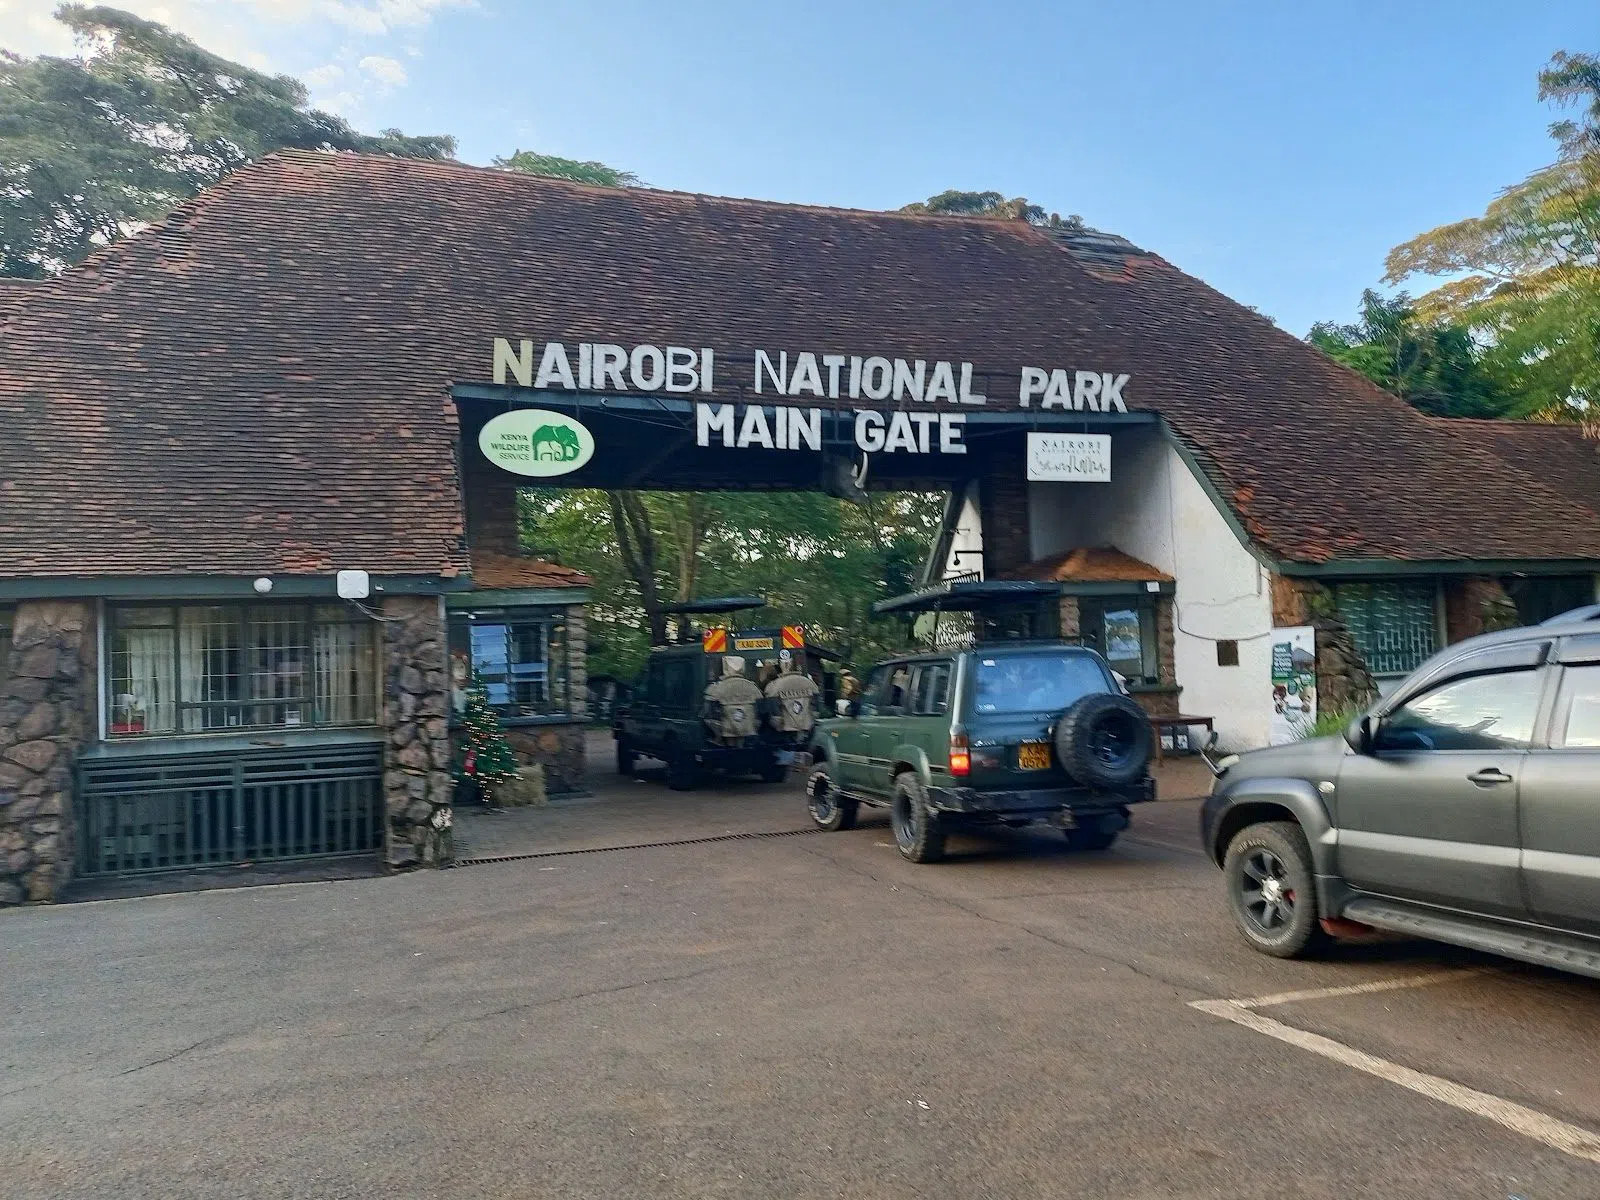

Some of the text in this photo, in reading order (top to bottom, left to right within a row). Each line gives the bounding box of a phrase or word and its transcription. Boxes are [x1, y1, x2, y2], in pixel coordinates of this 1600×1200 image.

[493, 337, 1131, 414] NAIROBI NATIONAL PARK
[696, 403, 968, 454] MAIN GATE
[500, 433, 528, 442] KENYA
[490, 442, 530, 452] WILDLIFE
[499, 452, 530, 461] SERVICE
